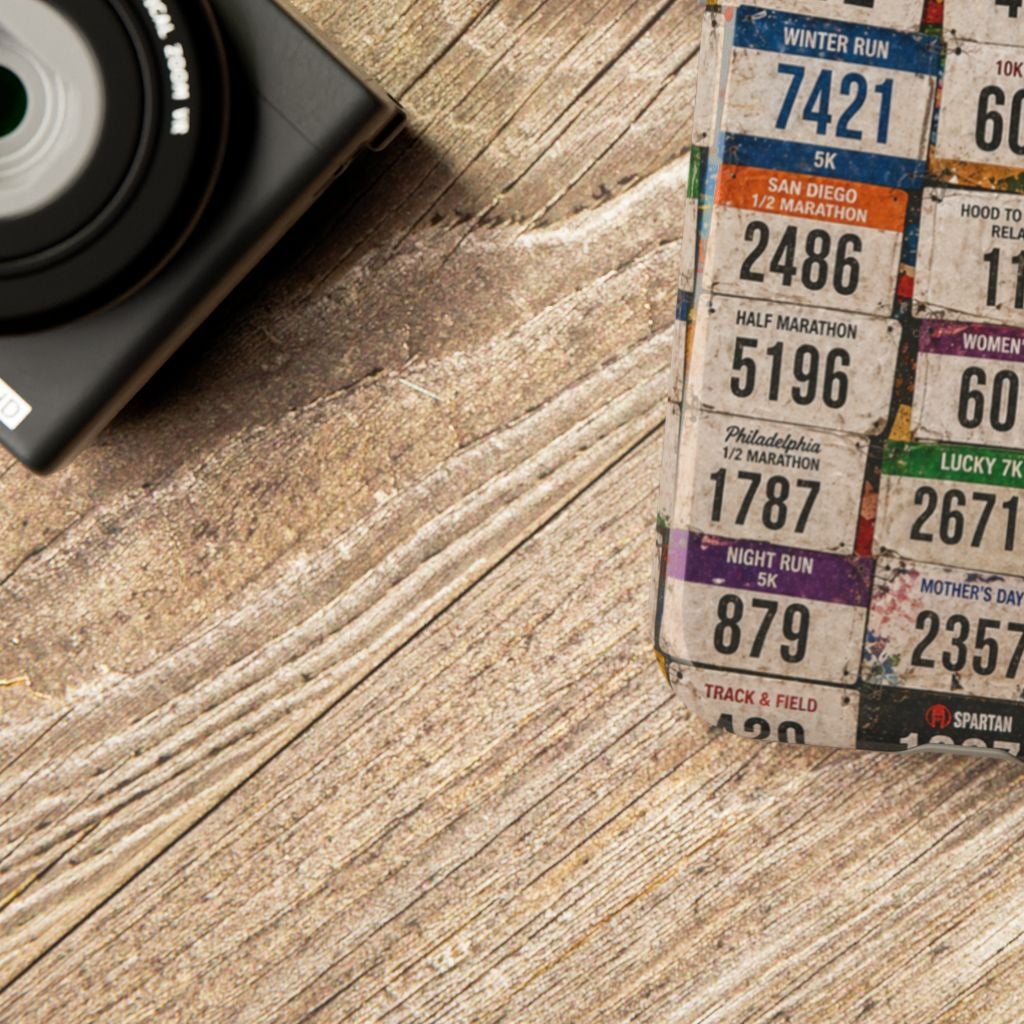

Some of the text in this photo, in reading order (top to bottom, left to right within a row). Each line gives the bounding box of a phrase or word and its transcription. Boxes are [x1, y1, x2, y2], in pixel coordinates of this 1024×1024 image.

[783, 27, 890, 59] WINTER RUN
[164, 42, 190, 100] ZOOM
[996, 60, 1024, 77] 10K
[775, 63, 894, 144] 7421
[814, 151, 837, 171] 5K
[768, 178, 858, 204] SAN DIEGO
[751, 193, 868, 223] 1/2 MARATHON
[961, 204, 1000, 220] HOOD
[1005, 209, 1022, 223] TO
[739, 221, 862, 295] 2486
[736, 310, 857, 339] HALF MARATHON
[730, 336, 851, 409] 5196
[724, 425, 822, 454] Philadelphia
[723, 447, 820, 471] 1/2 MARATHON
[940, 452, 1023, 478] LUCKY 7K
[710, 468, 821, 534] 1787
[910, 486, 1019, 552] 2671
[726, 546, 814, 574] NIGHT RUN
[757, 572, 778, 588] 5K
[920, 578, 992, 602] MOTHER'S
[996, 588, 1024, 605] DAY
[713, 594, 810, 664] 879
[704, 683, 818, 712] TRACK & FIELD
[953, 711, 1013, 732] SPARTAN
